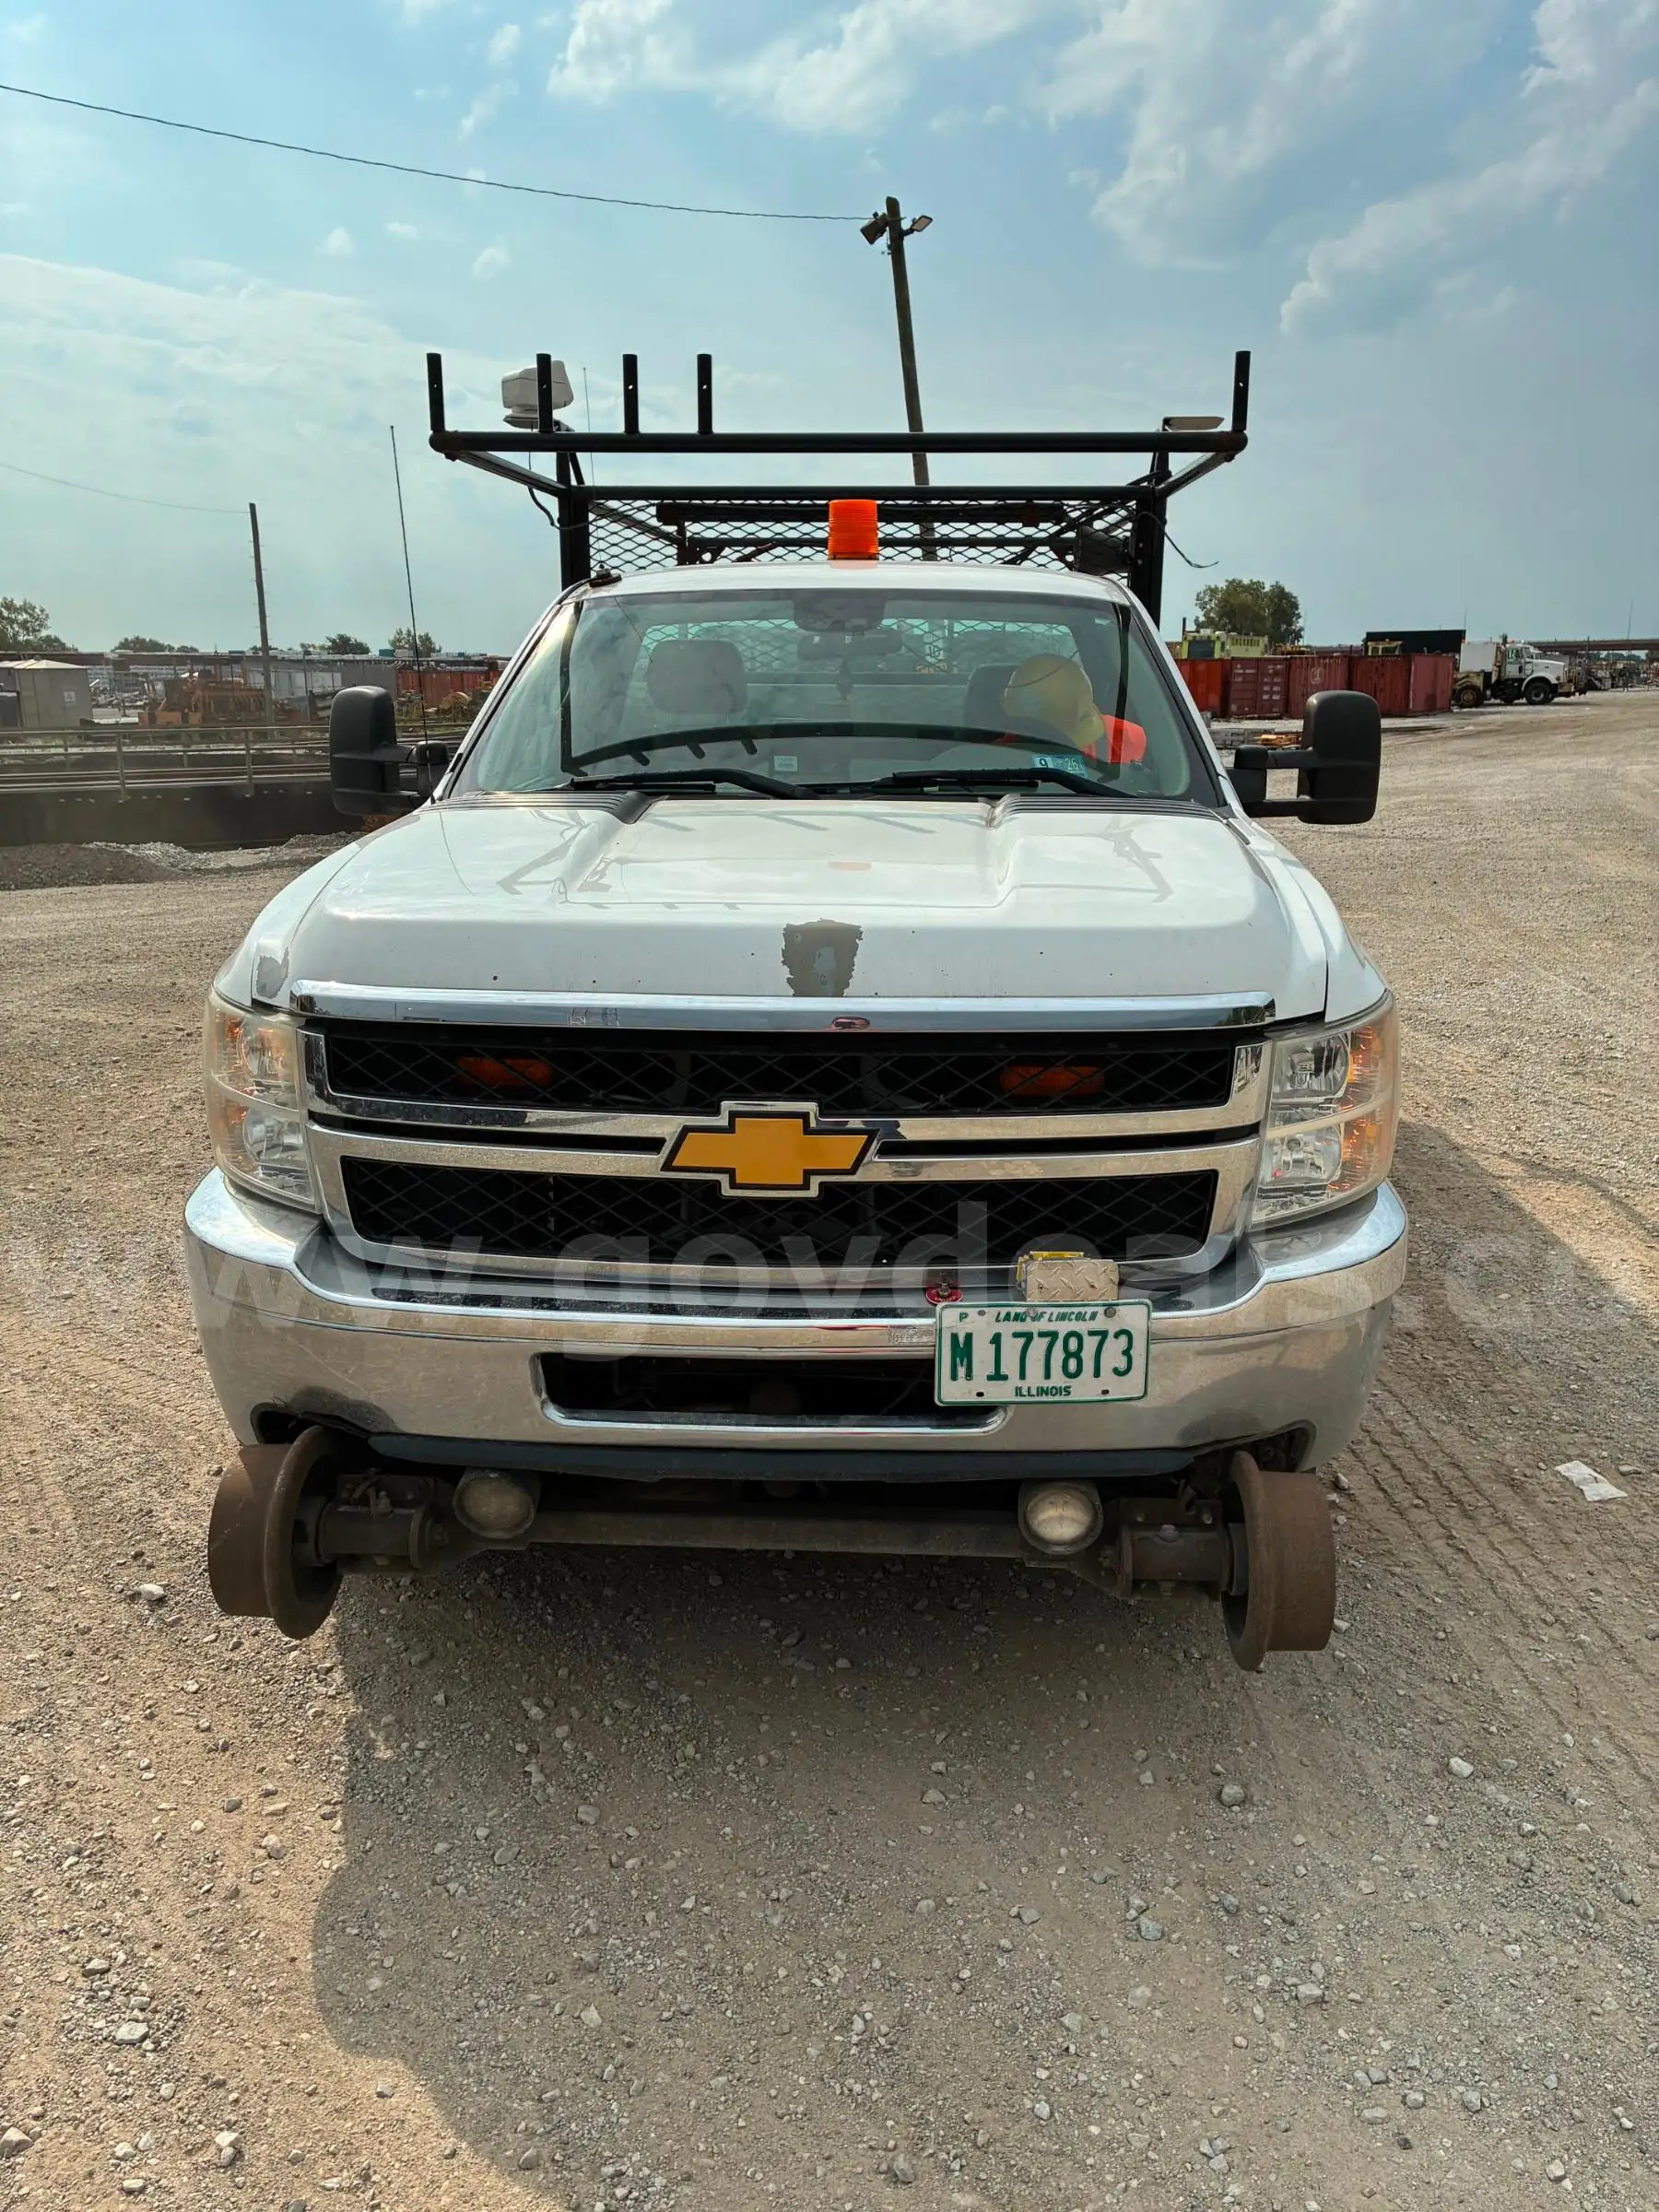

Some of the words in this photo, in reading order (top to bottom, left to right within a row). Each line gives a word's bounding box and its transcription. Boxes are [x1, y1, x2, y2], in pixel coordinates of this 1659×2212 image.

[959, 1312, 970, 1323] P
[995, 1311, 1028, 1323] LAND
[1048, 1311, 1099, 1323] LINCOLN
[986, 1328, 1135, 1382] 177873
[1015, 1385, 1072, 1397] ILLINOIS
